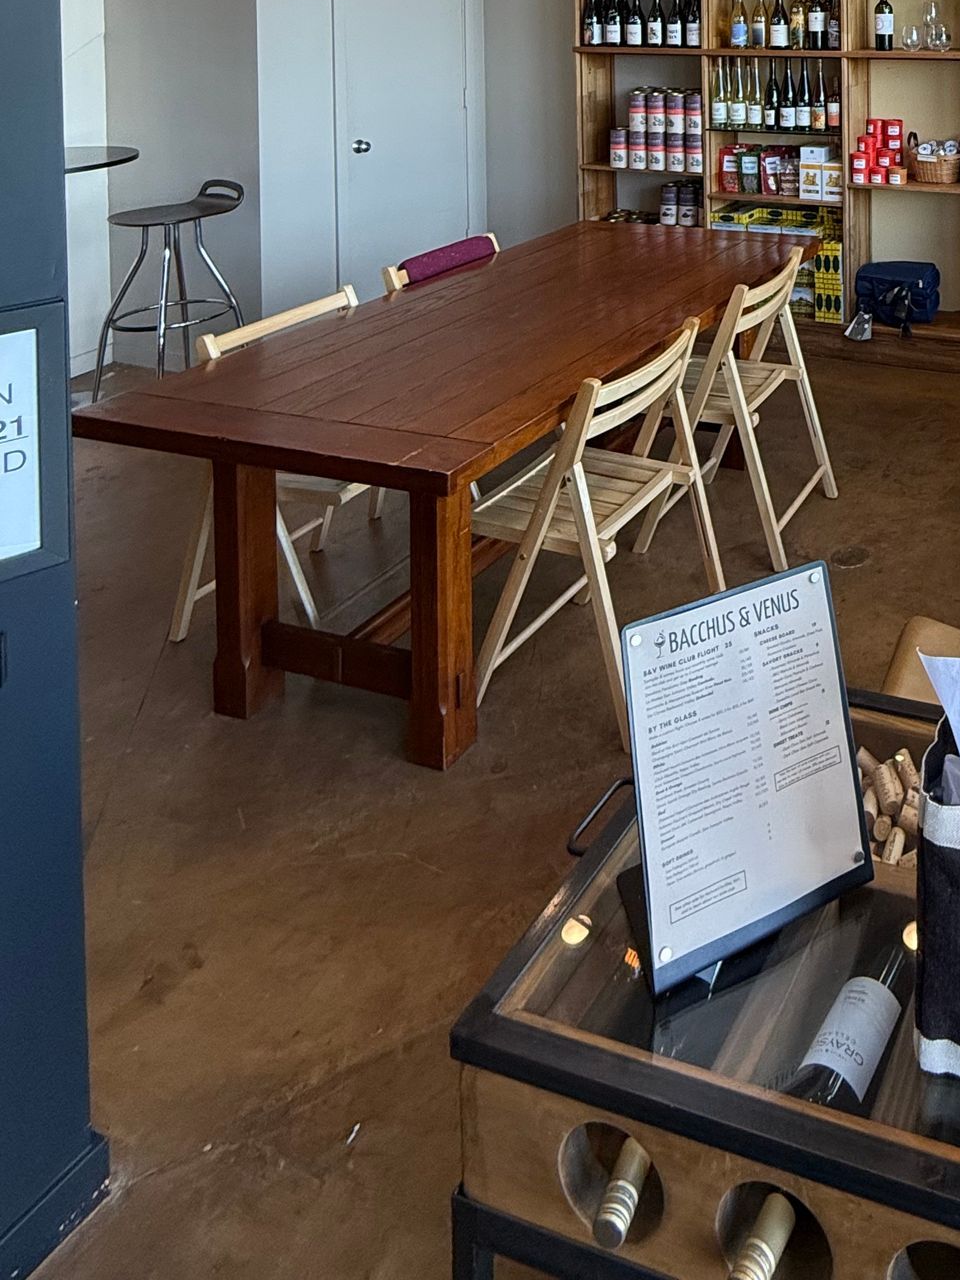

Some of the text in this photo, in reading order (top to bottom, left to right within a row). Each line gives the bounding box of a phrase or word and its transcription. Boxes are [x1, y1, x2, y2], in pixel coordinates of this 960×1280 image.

[668, 610, 735, 654] BACCHUS
[738, 605, 751, 629] &
[753, 588, 800, 623] VENUS
[753, 623, 779, 638] SNACKS
[658, 660, 676, 672] WINE
[678, 653, 696, 665] CLUB
[696, 644, 719, 659] FLIGHT
[647, 709, 697, 734] BY THE GLASS
